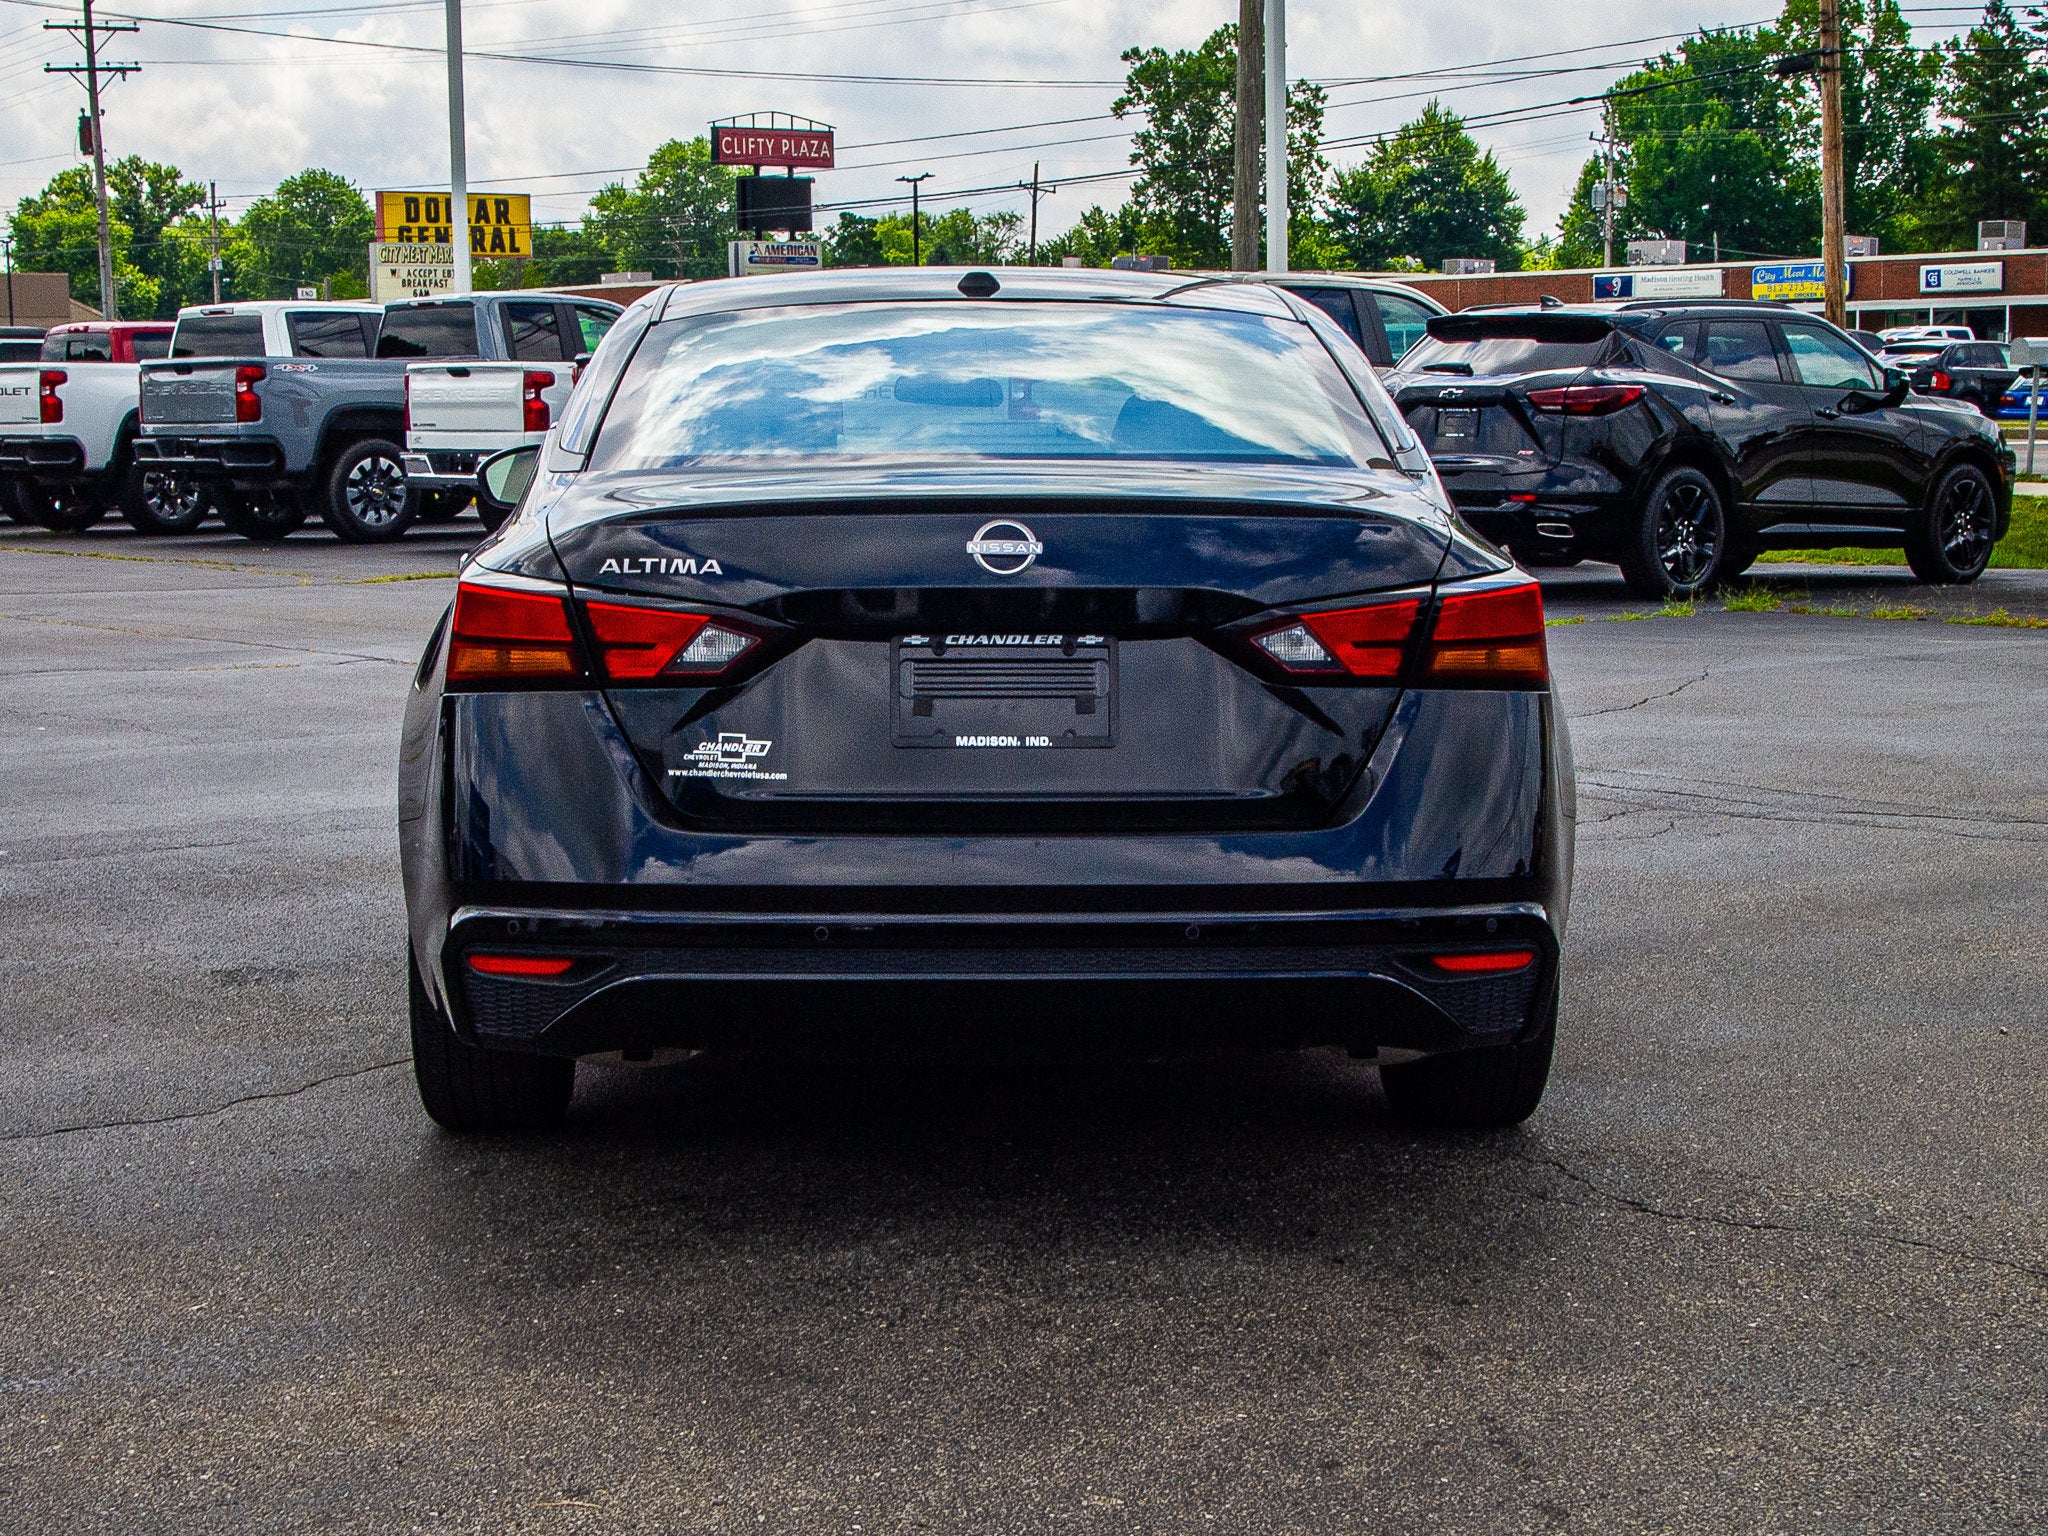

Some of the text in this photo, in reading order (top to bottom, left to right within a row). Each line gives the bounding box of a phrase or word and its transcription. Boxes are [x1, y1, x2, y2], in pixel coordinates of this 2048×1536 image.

[721, 136, 830, 158] CLIFTY PLAZA
[404, 197, 511, 224] DOLAR
[398, 225, 520, 253] GENRAL
[379, 245, 454, 265] CITY MEAT MAR
[764, 244, 818, 256] AMERICAN
[406, 269, 438, 278] ACCEPT
[401, 279, 448, 288] BREAKFAST
[413, 289, 430, 297] 6AM
[968, 543, 1041, 553] NISSAN
[599, 558, 723, 575] ALTIMA
[945, 635, 1063, 645] CHANDLER
[698, 741, 761, 753] CHANDLER
[955, 736, 1053, 747] MADISON, IND.
[683, 753, 718, 761] CHEVROLET
[698, 762, 730, 770] MADISON,
